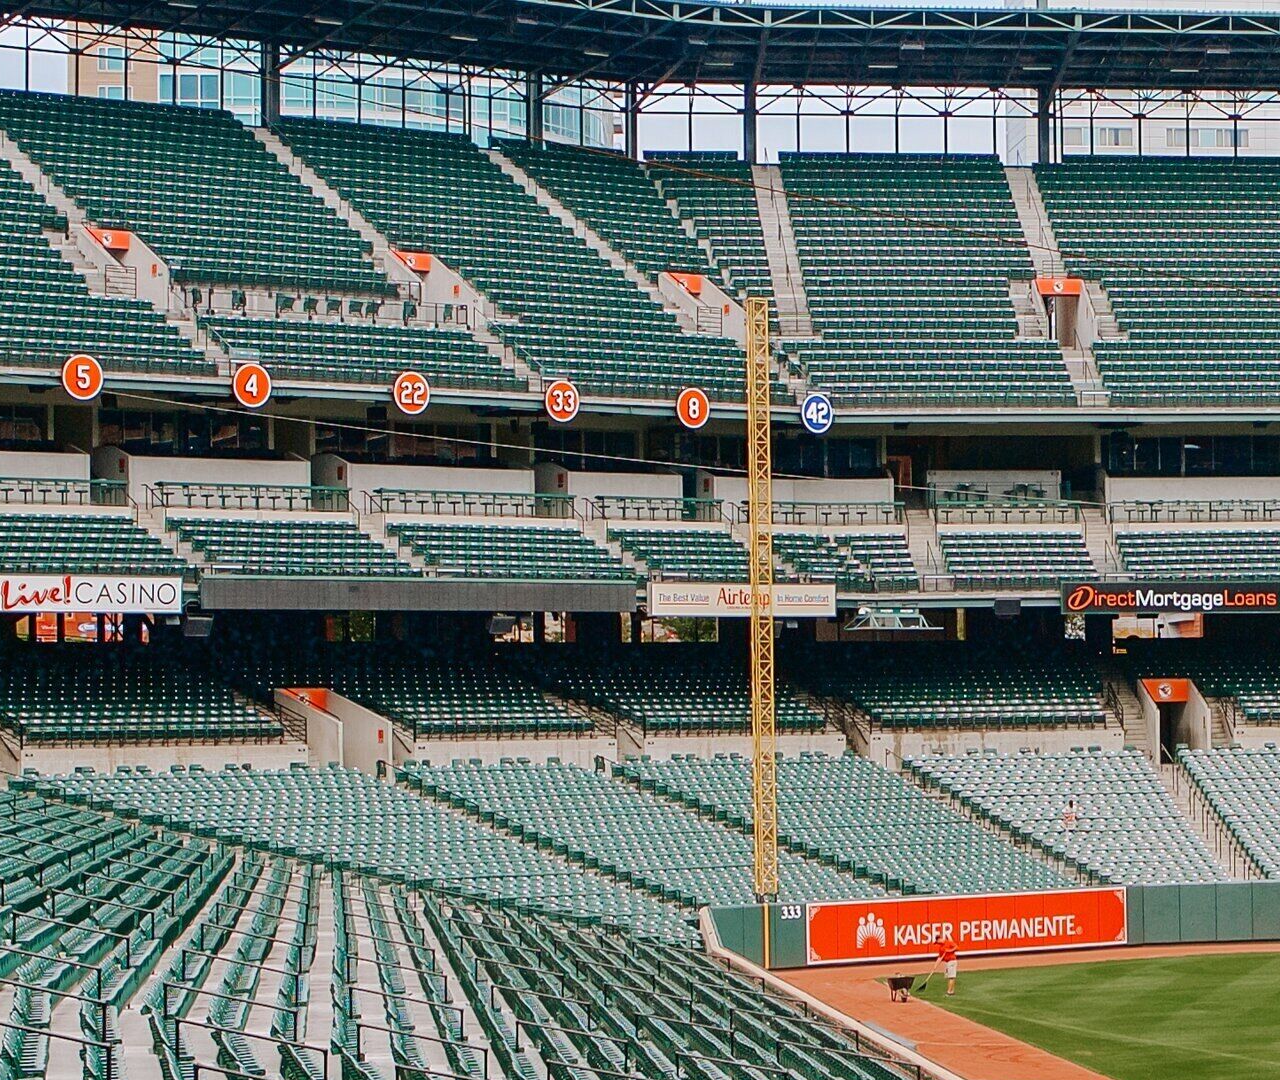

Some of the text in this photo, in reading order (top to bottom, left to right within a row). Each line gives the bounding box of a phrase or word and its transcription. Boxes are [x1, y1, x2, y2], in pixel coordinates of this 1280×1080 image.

[76, 364, 91, 389] 5
[244, 373, 258, 397] 4
[400, 381, 426, 406] 22
[552, 388, 575, 413] 33
[688, 397, 700, 419] 8
[805, 402, 829, 425] 42
[1, 575, 177, 610] Live! CASINO
[658, 593, 710, 602] The Best Value
[785, 594, 803, 603] Home
[805, 594, 829, 603] Comfort
[781, 905, 802, 920] 333
[893, 915, 1076, 946] KAISER PERMANENTE
